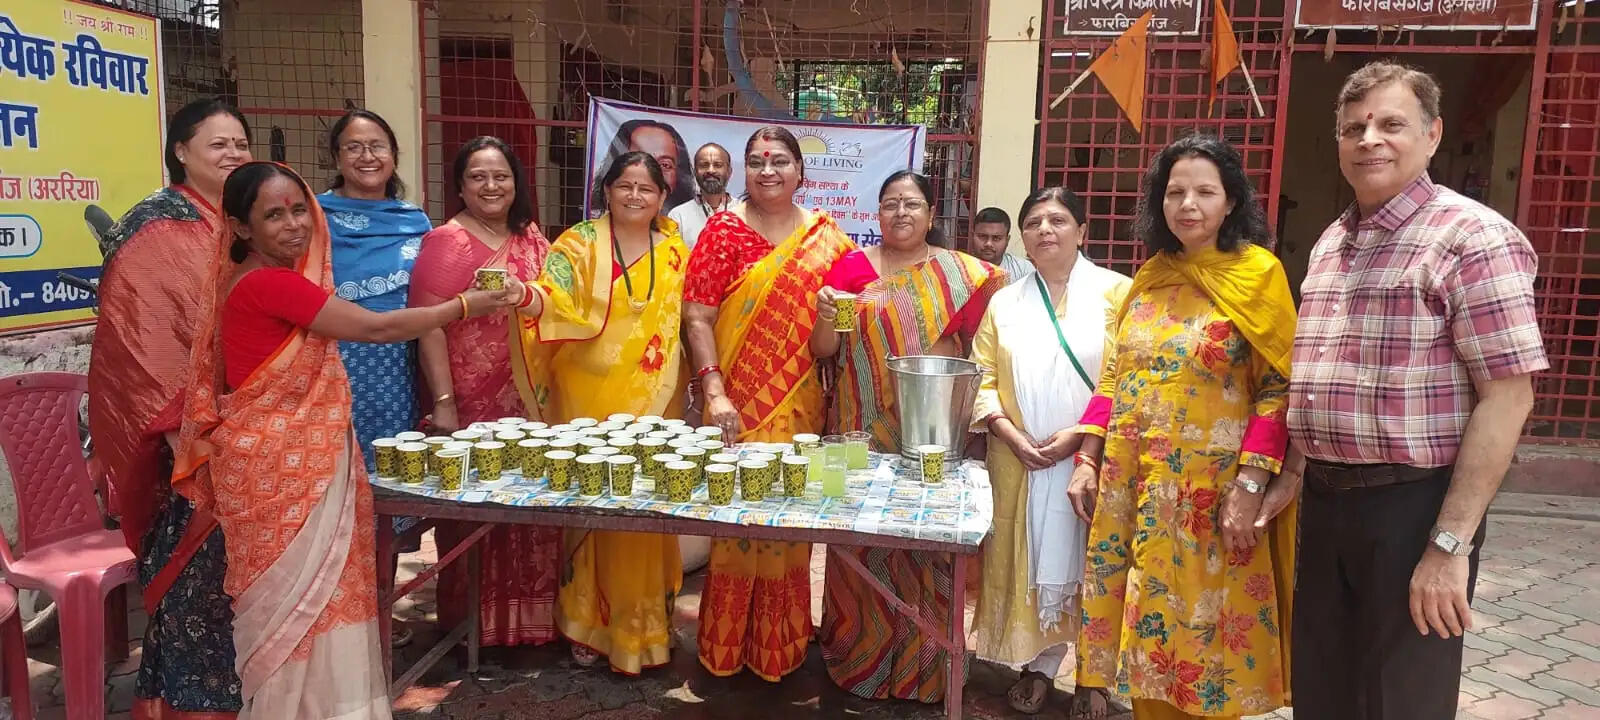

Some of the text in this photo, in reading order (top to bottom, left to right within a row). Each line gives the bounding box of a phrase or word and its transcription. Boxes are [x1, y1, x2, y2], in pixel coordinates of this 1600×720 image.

[76, 15, 97, 28] जय
[101, 17, 114, 32] श्री
[117, 24, 136, 36] राम
[62, 34, 149, 95] रविवार
[804, 157, 863, 169] OF LIVING
[29, 172, 99, 201] (अररिया)
[826, 196, 858, 207] 13MAY
